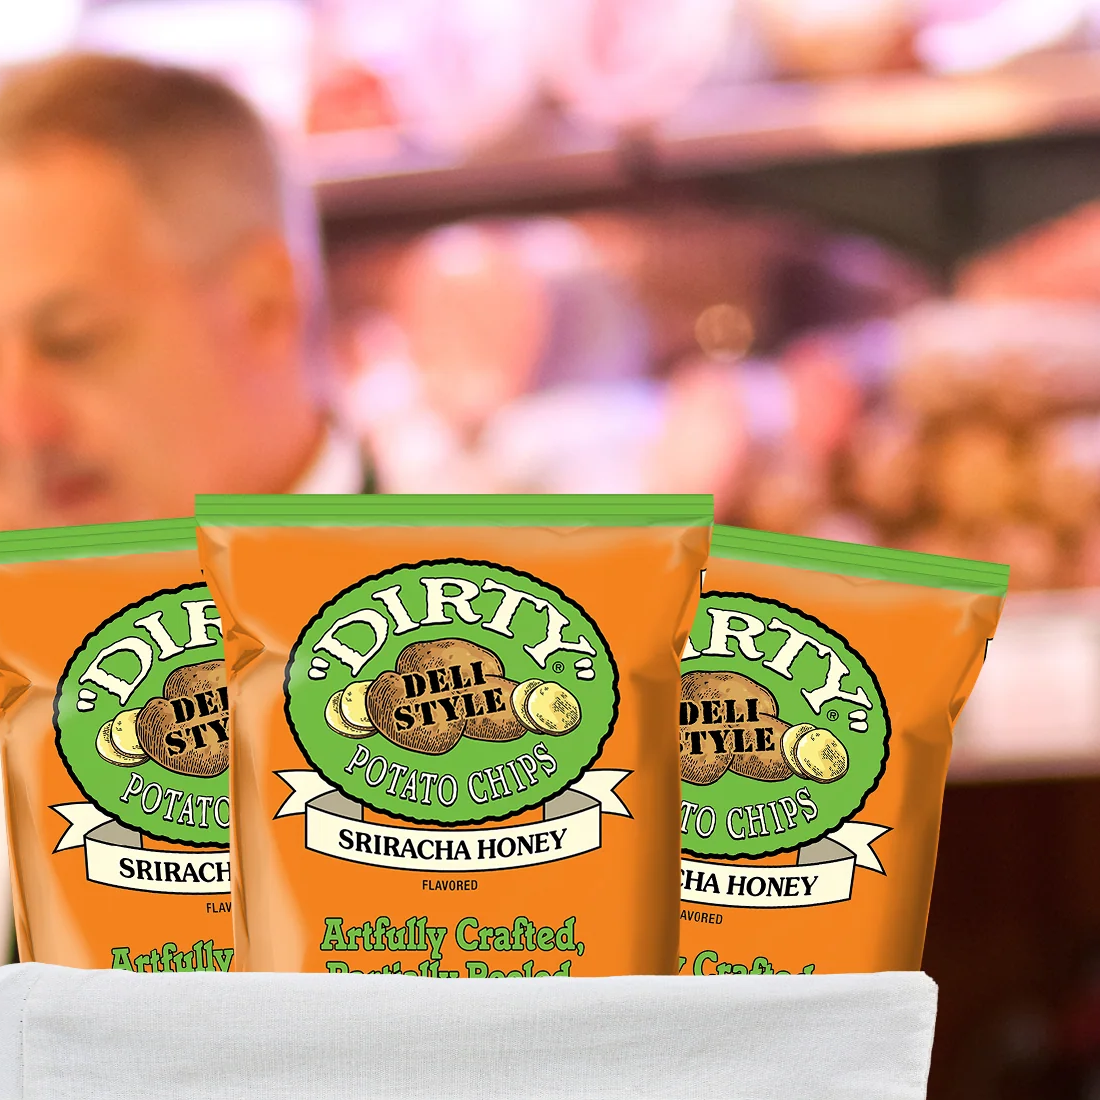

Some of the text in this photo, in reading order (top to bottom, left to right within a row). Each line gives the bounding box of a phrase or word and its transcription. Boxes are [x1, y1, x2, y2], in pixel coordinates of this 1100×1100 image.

[76, 600, 224, 712] "DIR
[401, 660, 487, 700] DELI
[170, 687, 229, 724] DE
[394, 688, 507, 731] STYLE
[680, 698, 759, 726] DELI
[165, 717, 229, 756] STY
[680, 727, 775, 755] TYLE
[344, 741, 559, 808] POTATO CHIPS
[726, 786, 818, 840] CHIPS
[338, 828, 568, 861] SRIRACHA HONEY
[119, 857, 231, 883] SRIRACH
[422, 879, 479, 892] FLAVORED
[726, 875, 818, 897] HONEY
[206, 902, 232, 914] FLAV
[680, 909, 723, 925] AVORED
[320, 916, 585, 960] Artfully Crafted,
